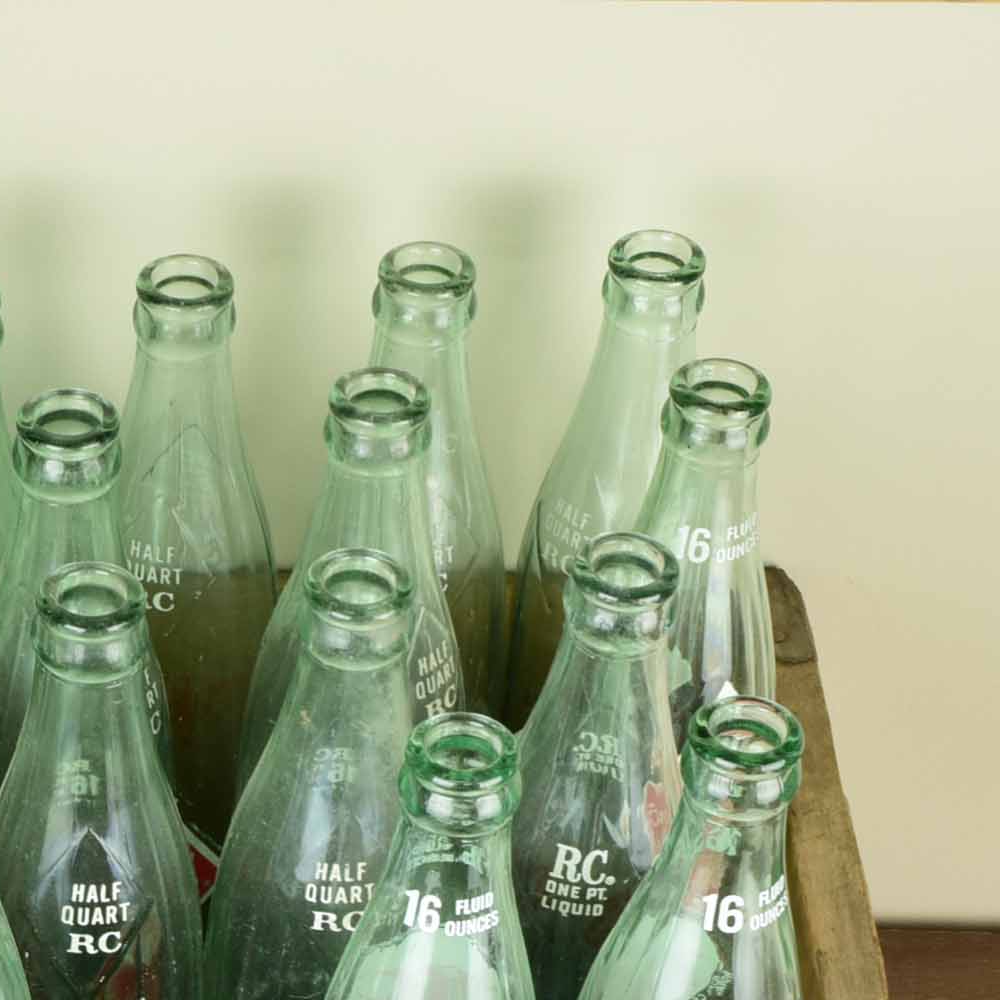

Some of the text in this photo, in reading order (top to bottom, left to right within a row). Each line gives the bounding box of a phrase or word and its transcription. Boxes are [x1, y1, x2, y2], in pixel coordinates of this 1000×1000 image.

[129, 539, 176, 564] HALF
[677, 525, 712, 564] 16
[314, 862, 368, 883] HALF
[71, 882, 123, 904] HALF
[304, 882, 375, 905] QUART
[545, 879, 582, 900] ONE
[60, 902, 131, 926] QUART
[402, 888, 494, 934] 16 FLUID
[540, 895, 605, 918] LIQUID
[702, 893, 745, 934] 16
[310, 910, 365, 933] RC
[444, 909, 500, 937] OUNCES
[66, 931, 123, 955] RC
